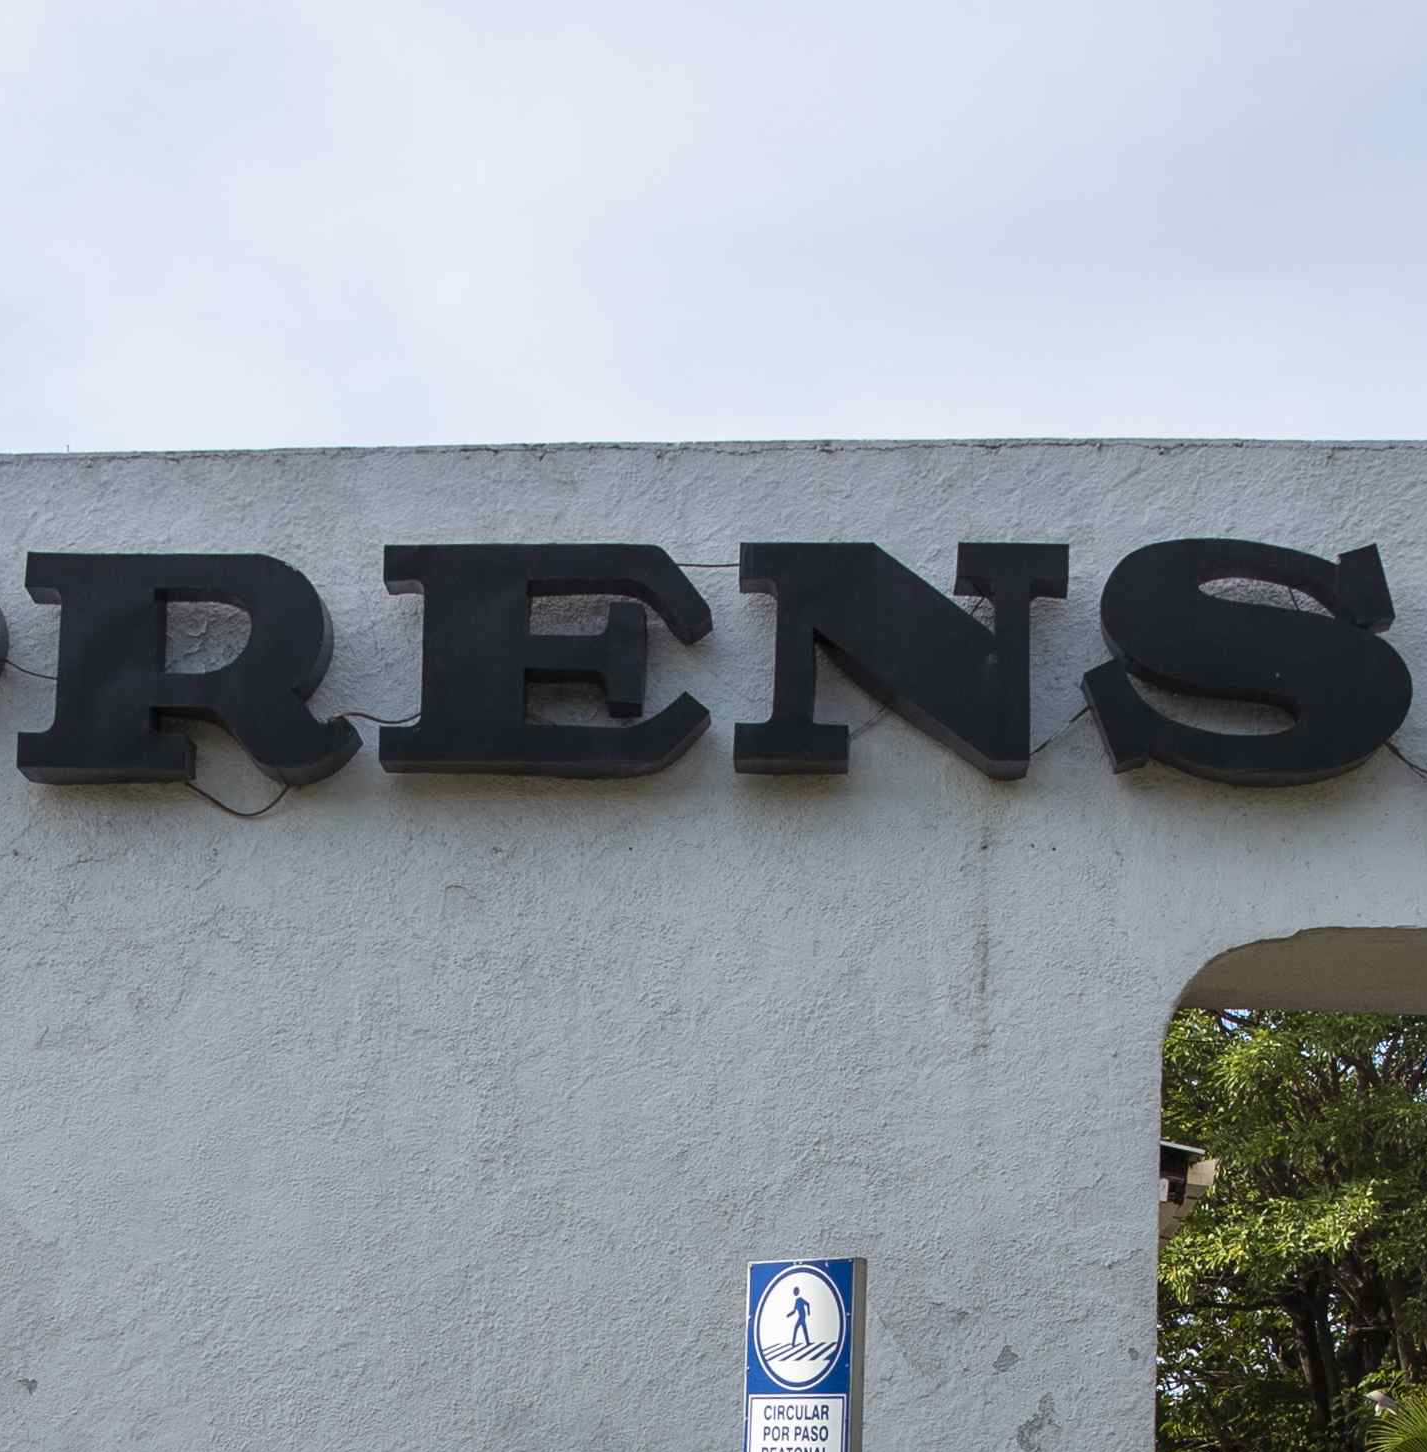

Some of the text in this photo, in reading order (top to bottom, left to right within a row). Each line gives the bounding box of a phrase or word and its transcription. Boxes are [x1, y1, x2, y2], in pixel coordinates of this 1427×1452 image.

[763, 1405, 830, 1421] CIRCULAR
[763, 1426, 829, 1442] POR PASO
